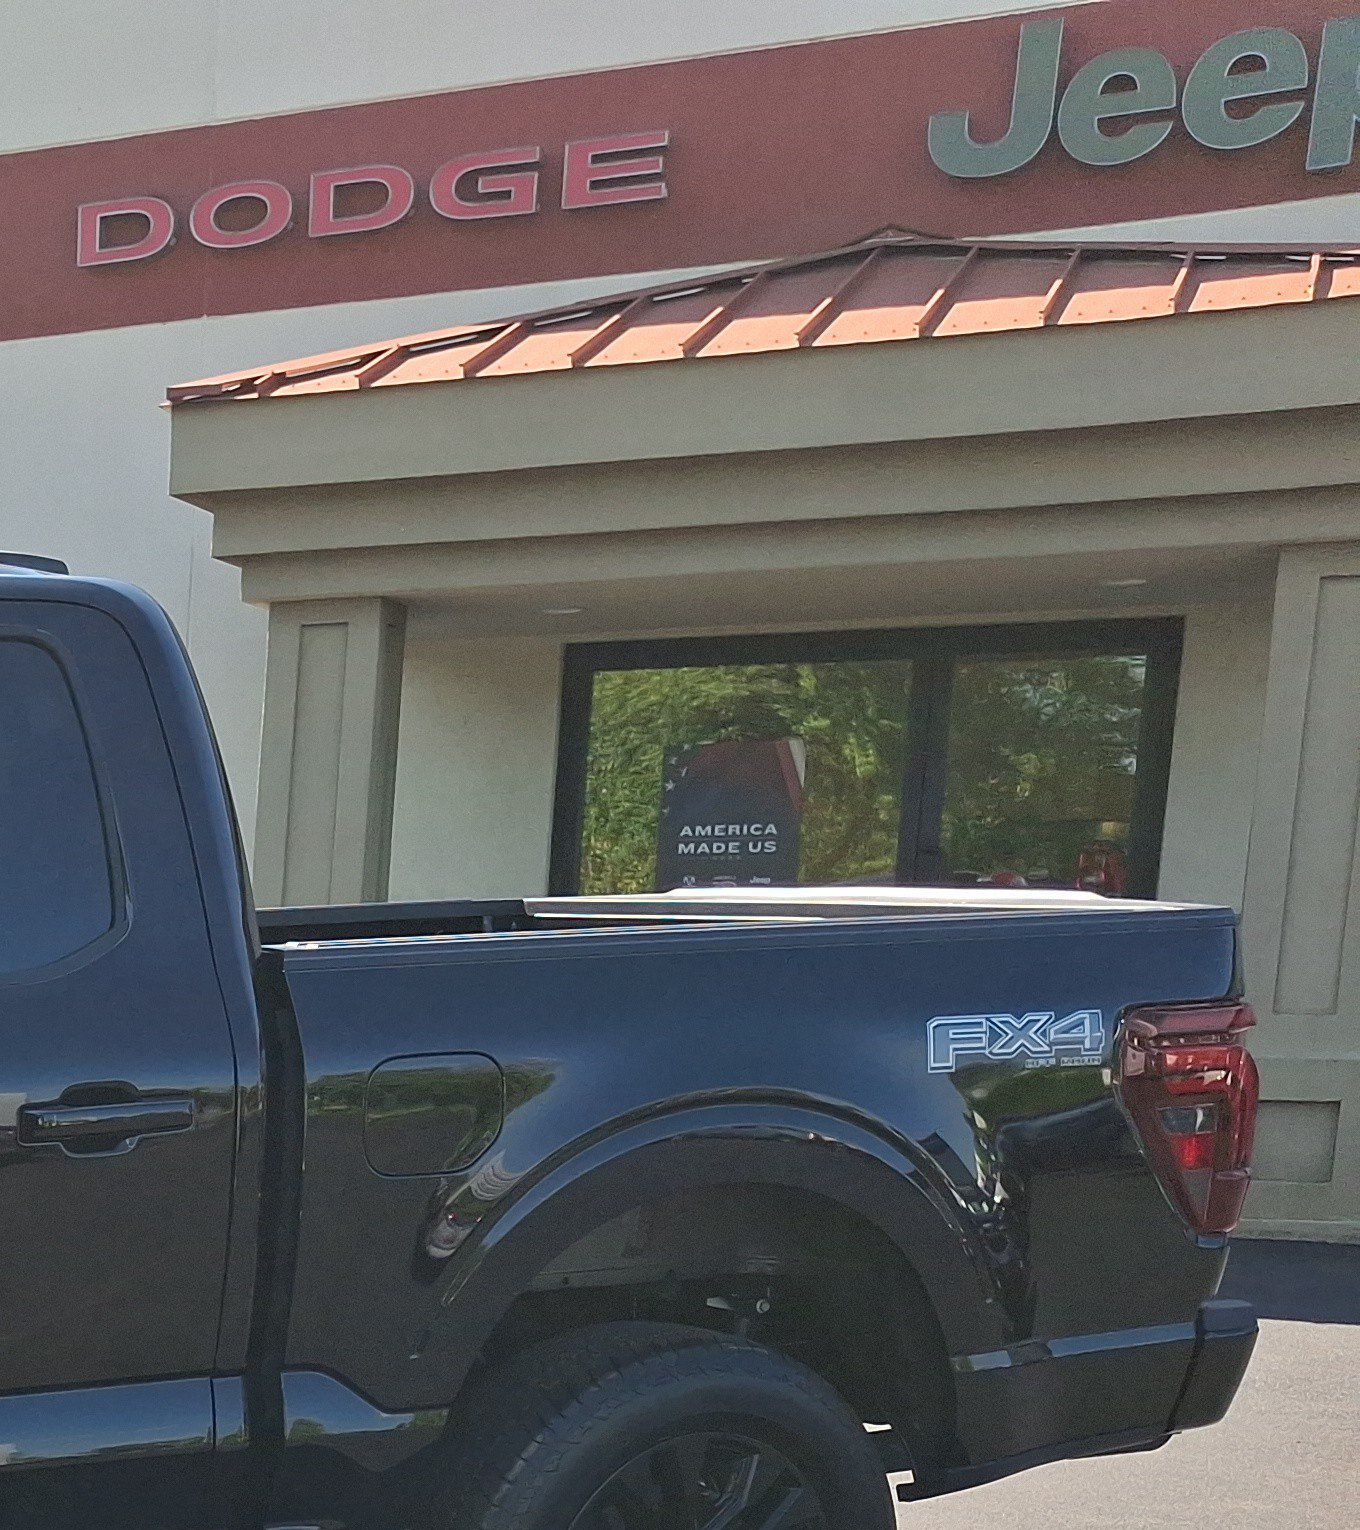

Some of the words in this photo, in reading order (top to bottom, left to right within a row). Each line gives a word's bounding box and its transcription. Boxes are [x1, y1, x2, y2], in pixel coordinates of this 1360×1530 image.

[77, 129, 671, 268] DODGE
[678, 842, 740, 855] MADE
[748, 841, 778, 853] US
[679, 822, 779, 837] AMERICA
[927, 1009, 1105, 1073] FX4
